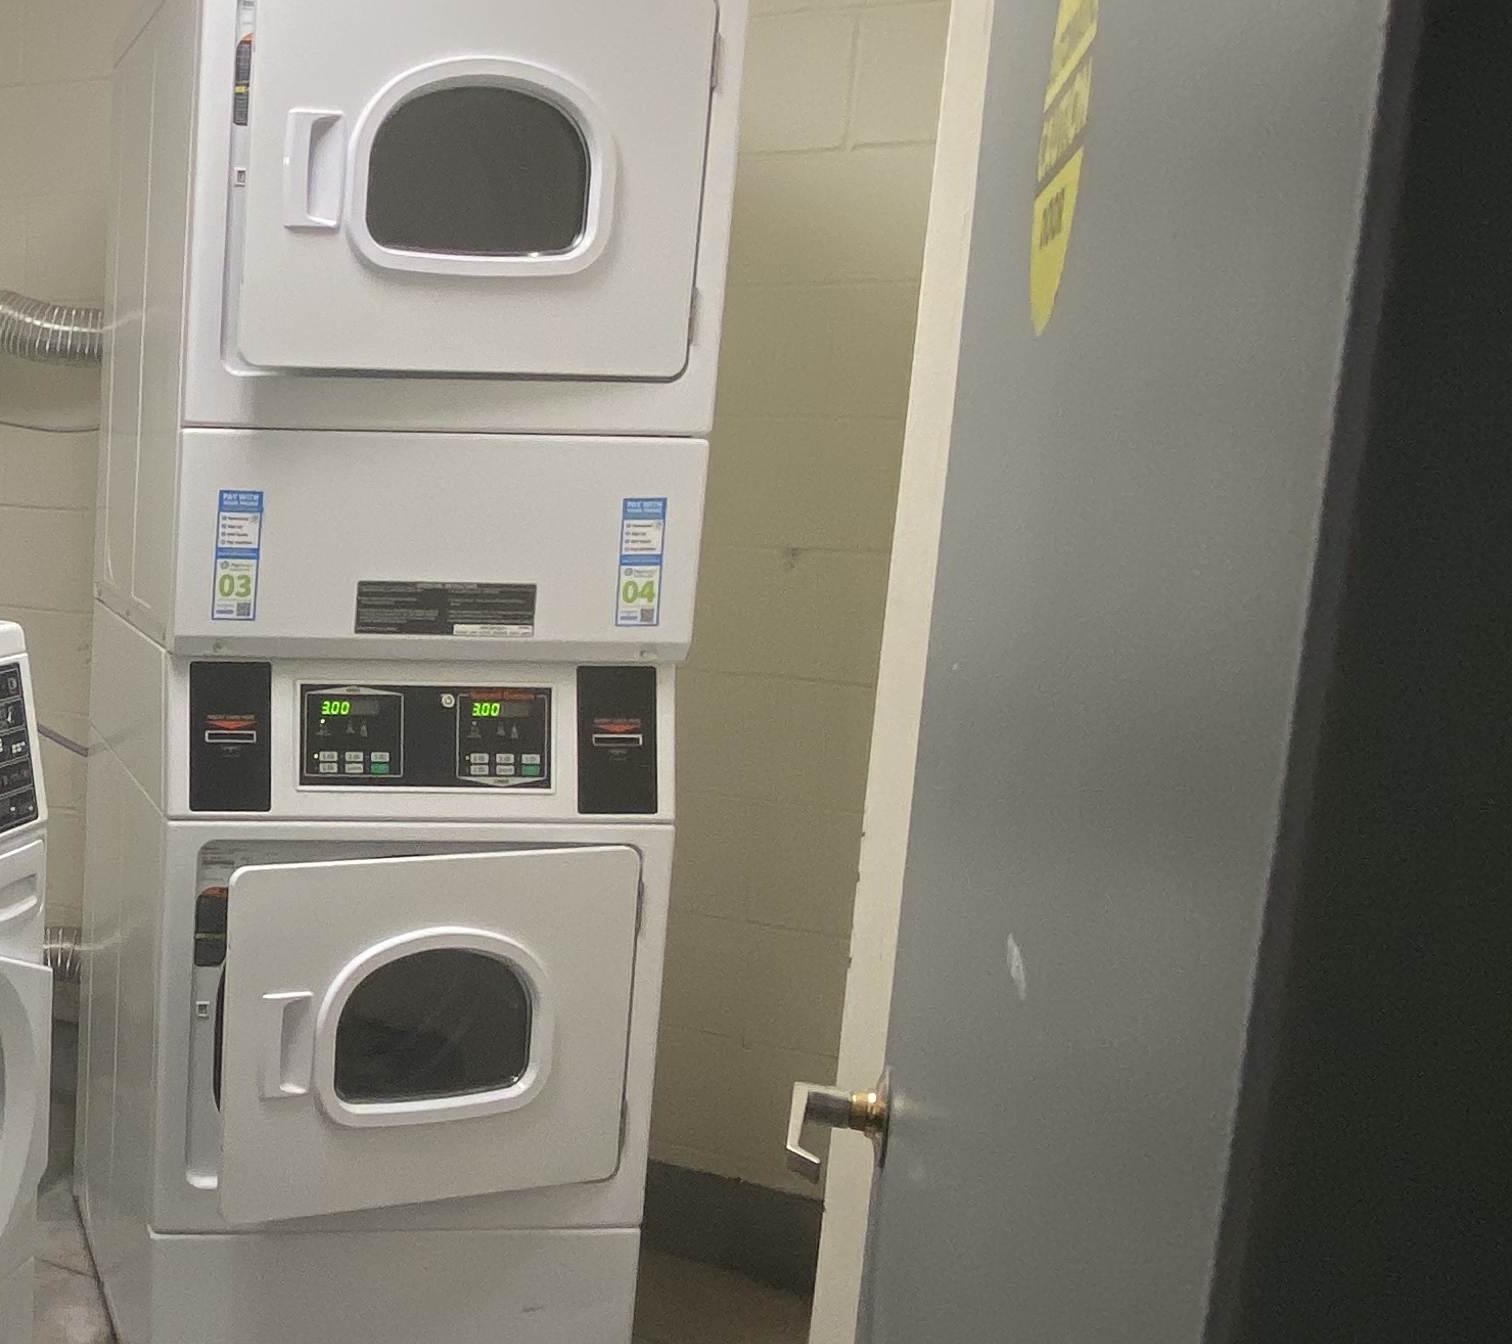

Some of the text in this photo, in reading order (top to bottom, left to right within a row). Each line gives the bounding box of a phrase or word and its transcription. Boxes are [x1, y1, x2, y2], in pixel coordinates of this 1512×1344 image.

[219, 574, 251, 598] 03
[622, 580, 656, 604] 04
[321, 700, 351, 716] 3.00
[471, 702, 501, 718] 3.00
